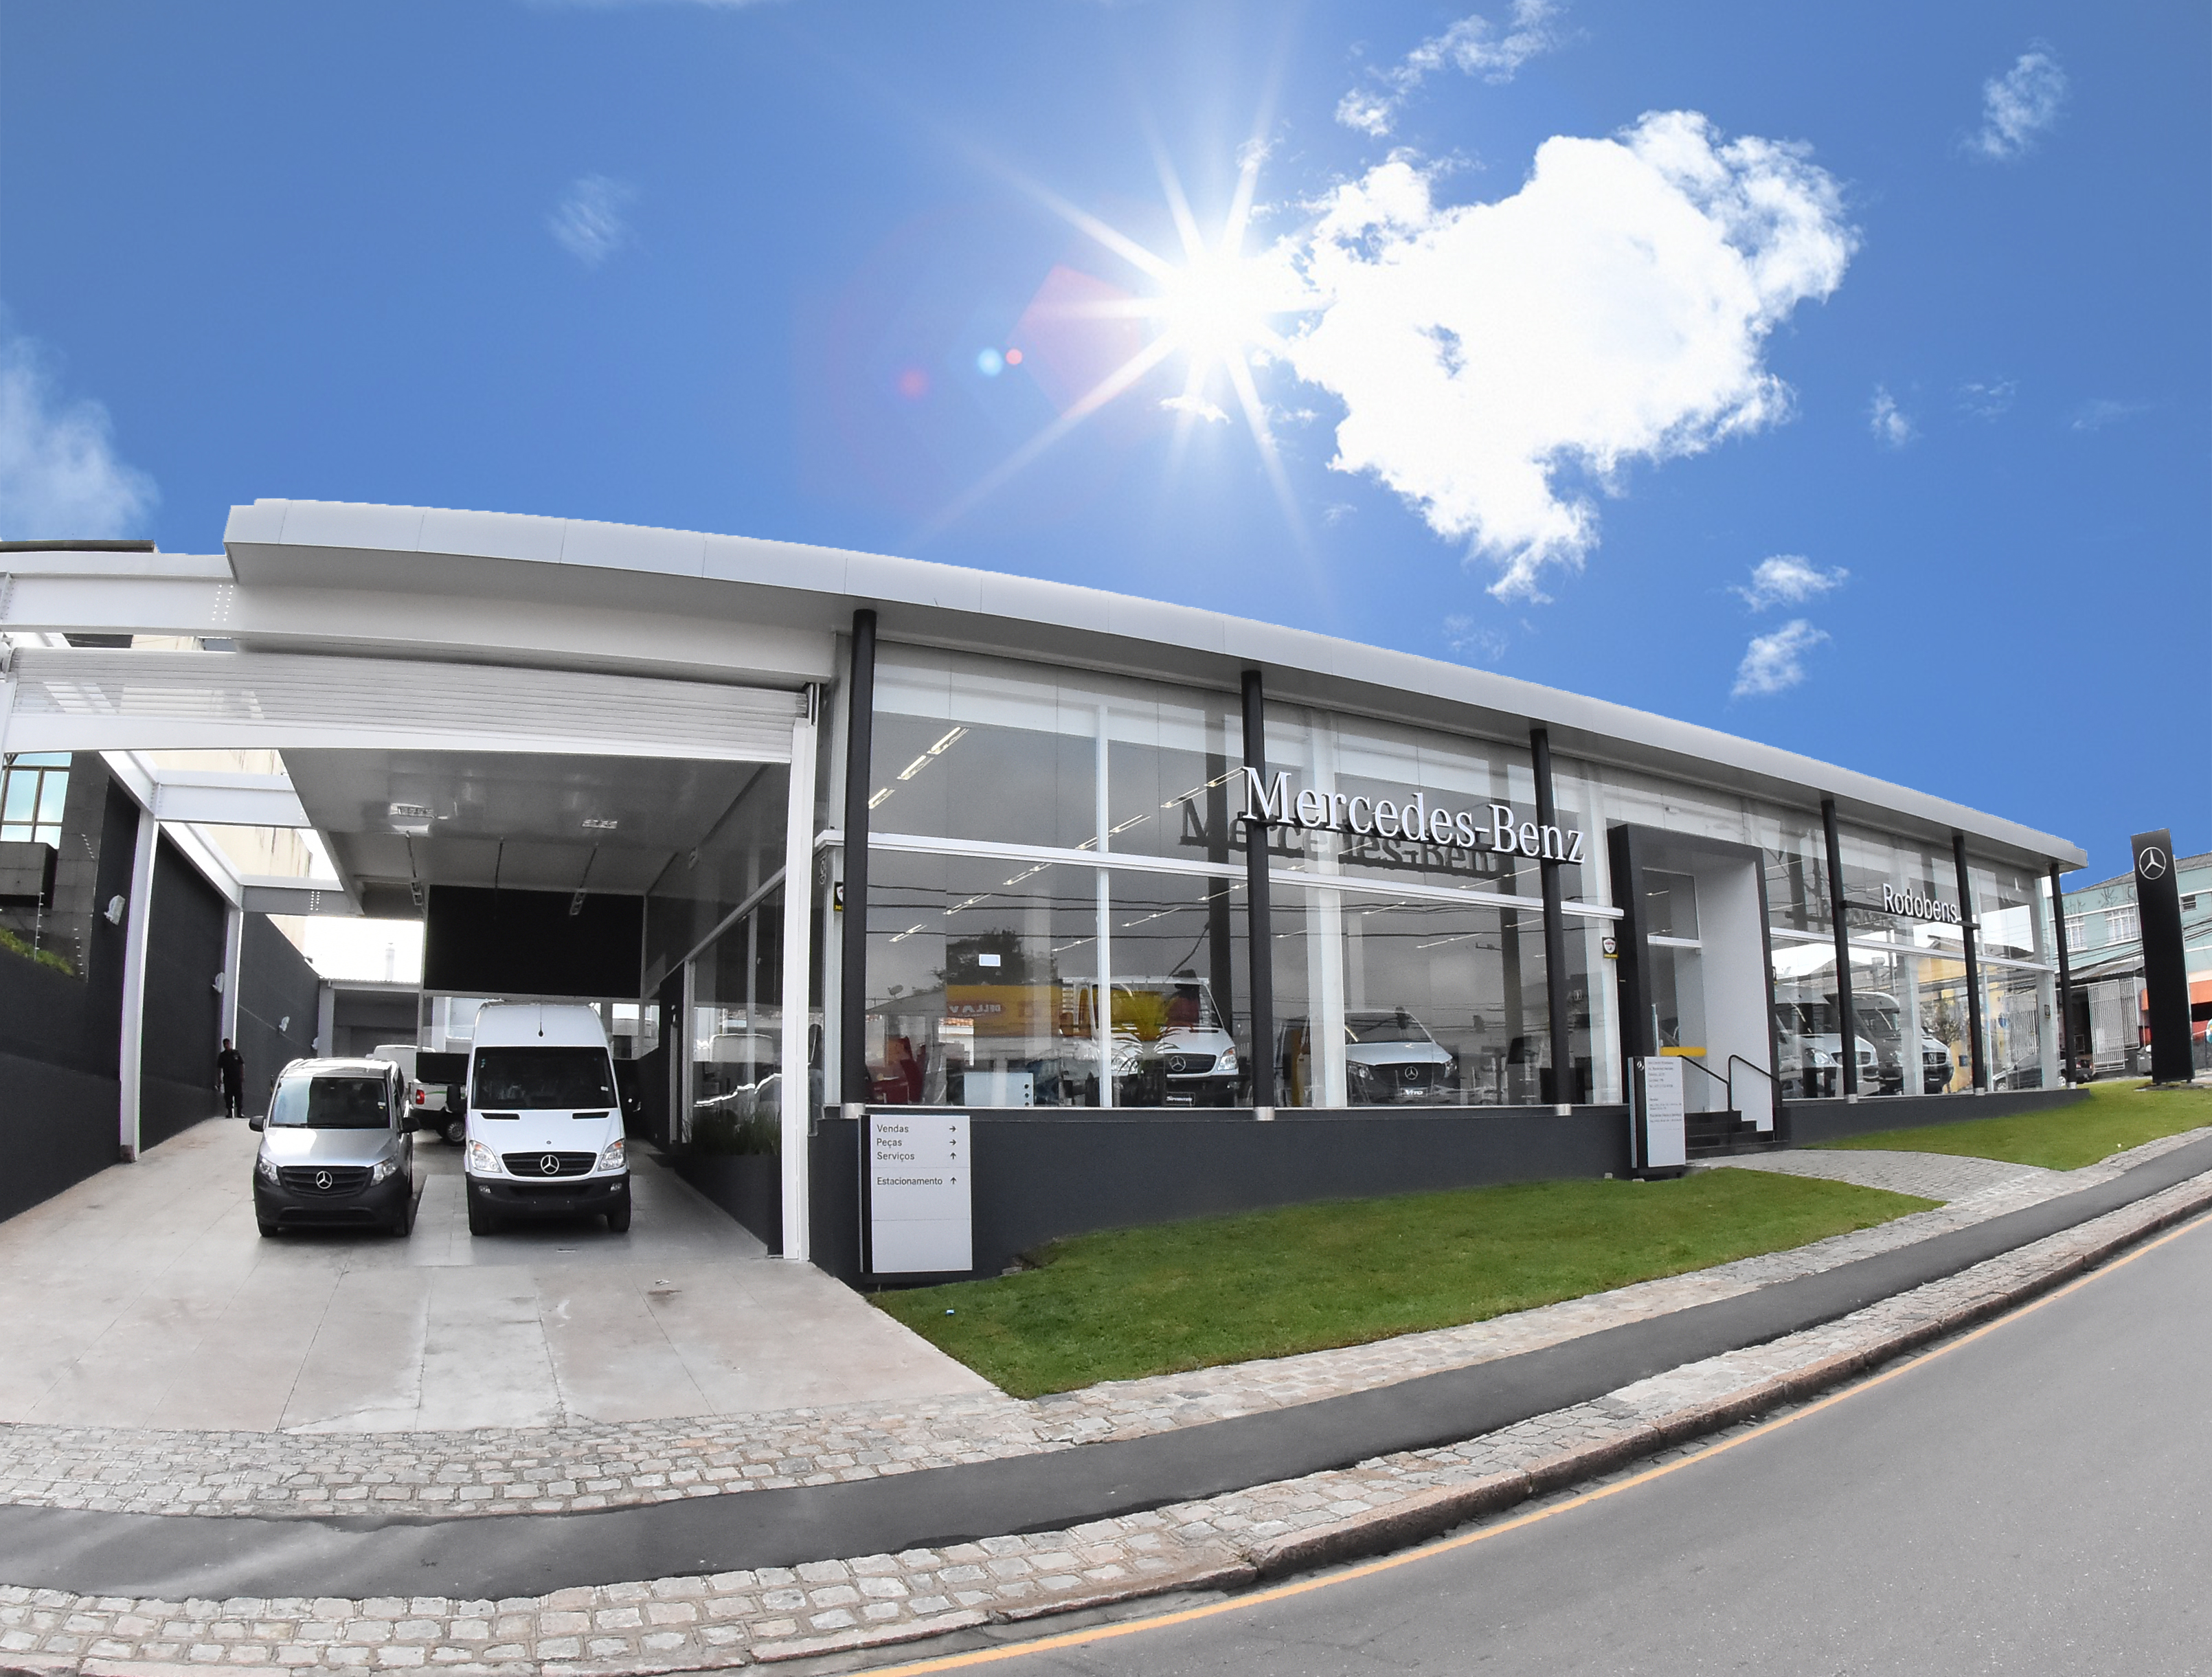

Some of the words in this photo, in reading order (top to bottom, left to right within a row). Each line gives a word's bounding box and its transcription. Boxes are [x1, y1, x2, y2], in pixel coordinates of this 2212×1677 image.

[1241, 766, 1586, 864] Mercedes-Benz
[1883, 883, 1957, 923] Rodobens
[877, 1125, 910, 1133] Vendas
[877, 1138, 903, 1149] Peças
[877, 1152, 915, 1162] Serviços
[877, 1177, 943, 1186] Estacionamento
